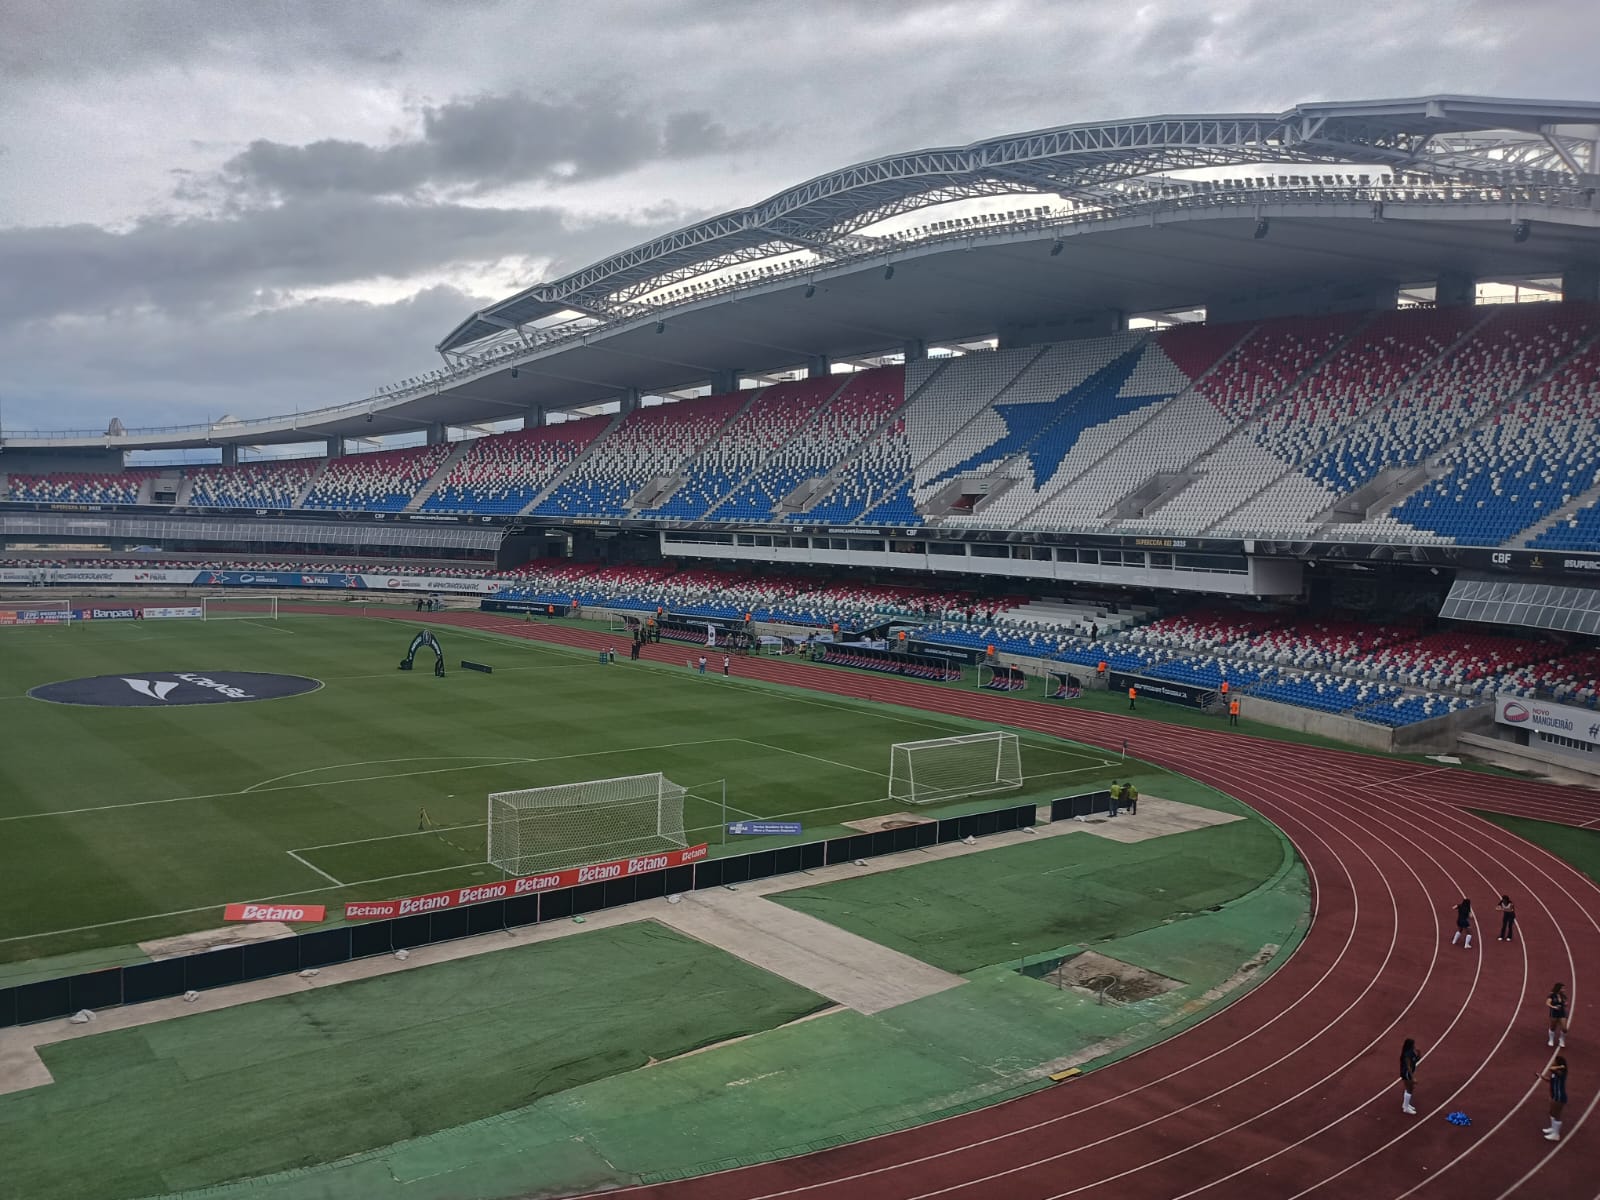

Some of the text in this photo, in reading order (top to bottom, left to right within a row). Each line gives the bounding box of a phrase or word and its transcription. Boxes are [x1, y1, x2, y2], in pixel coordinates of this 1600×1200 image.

[1492, 552, 1511, 564] CBF
[94, 608, 133, 619] Banpará
[1532, 708, 1550, 716] NOVO
[1532, 714, 1574, 731] MANGUEIRÃO
[681, 847, 706, 861] Betano
[627, 856, 668, 873] Betano
[578, 863, 621, 883] Betano
[514, 875, 560, 893] Betano
[458, 885, 506, 904] Betano
[242, 905, 304, 920] Betano
[346, 906, 393, 916] Betano
[399, 895, 450, 914] Betano
